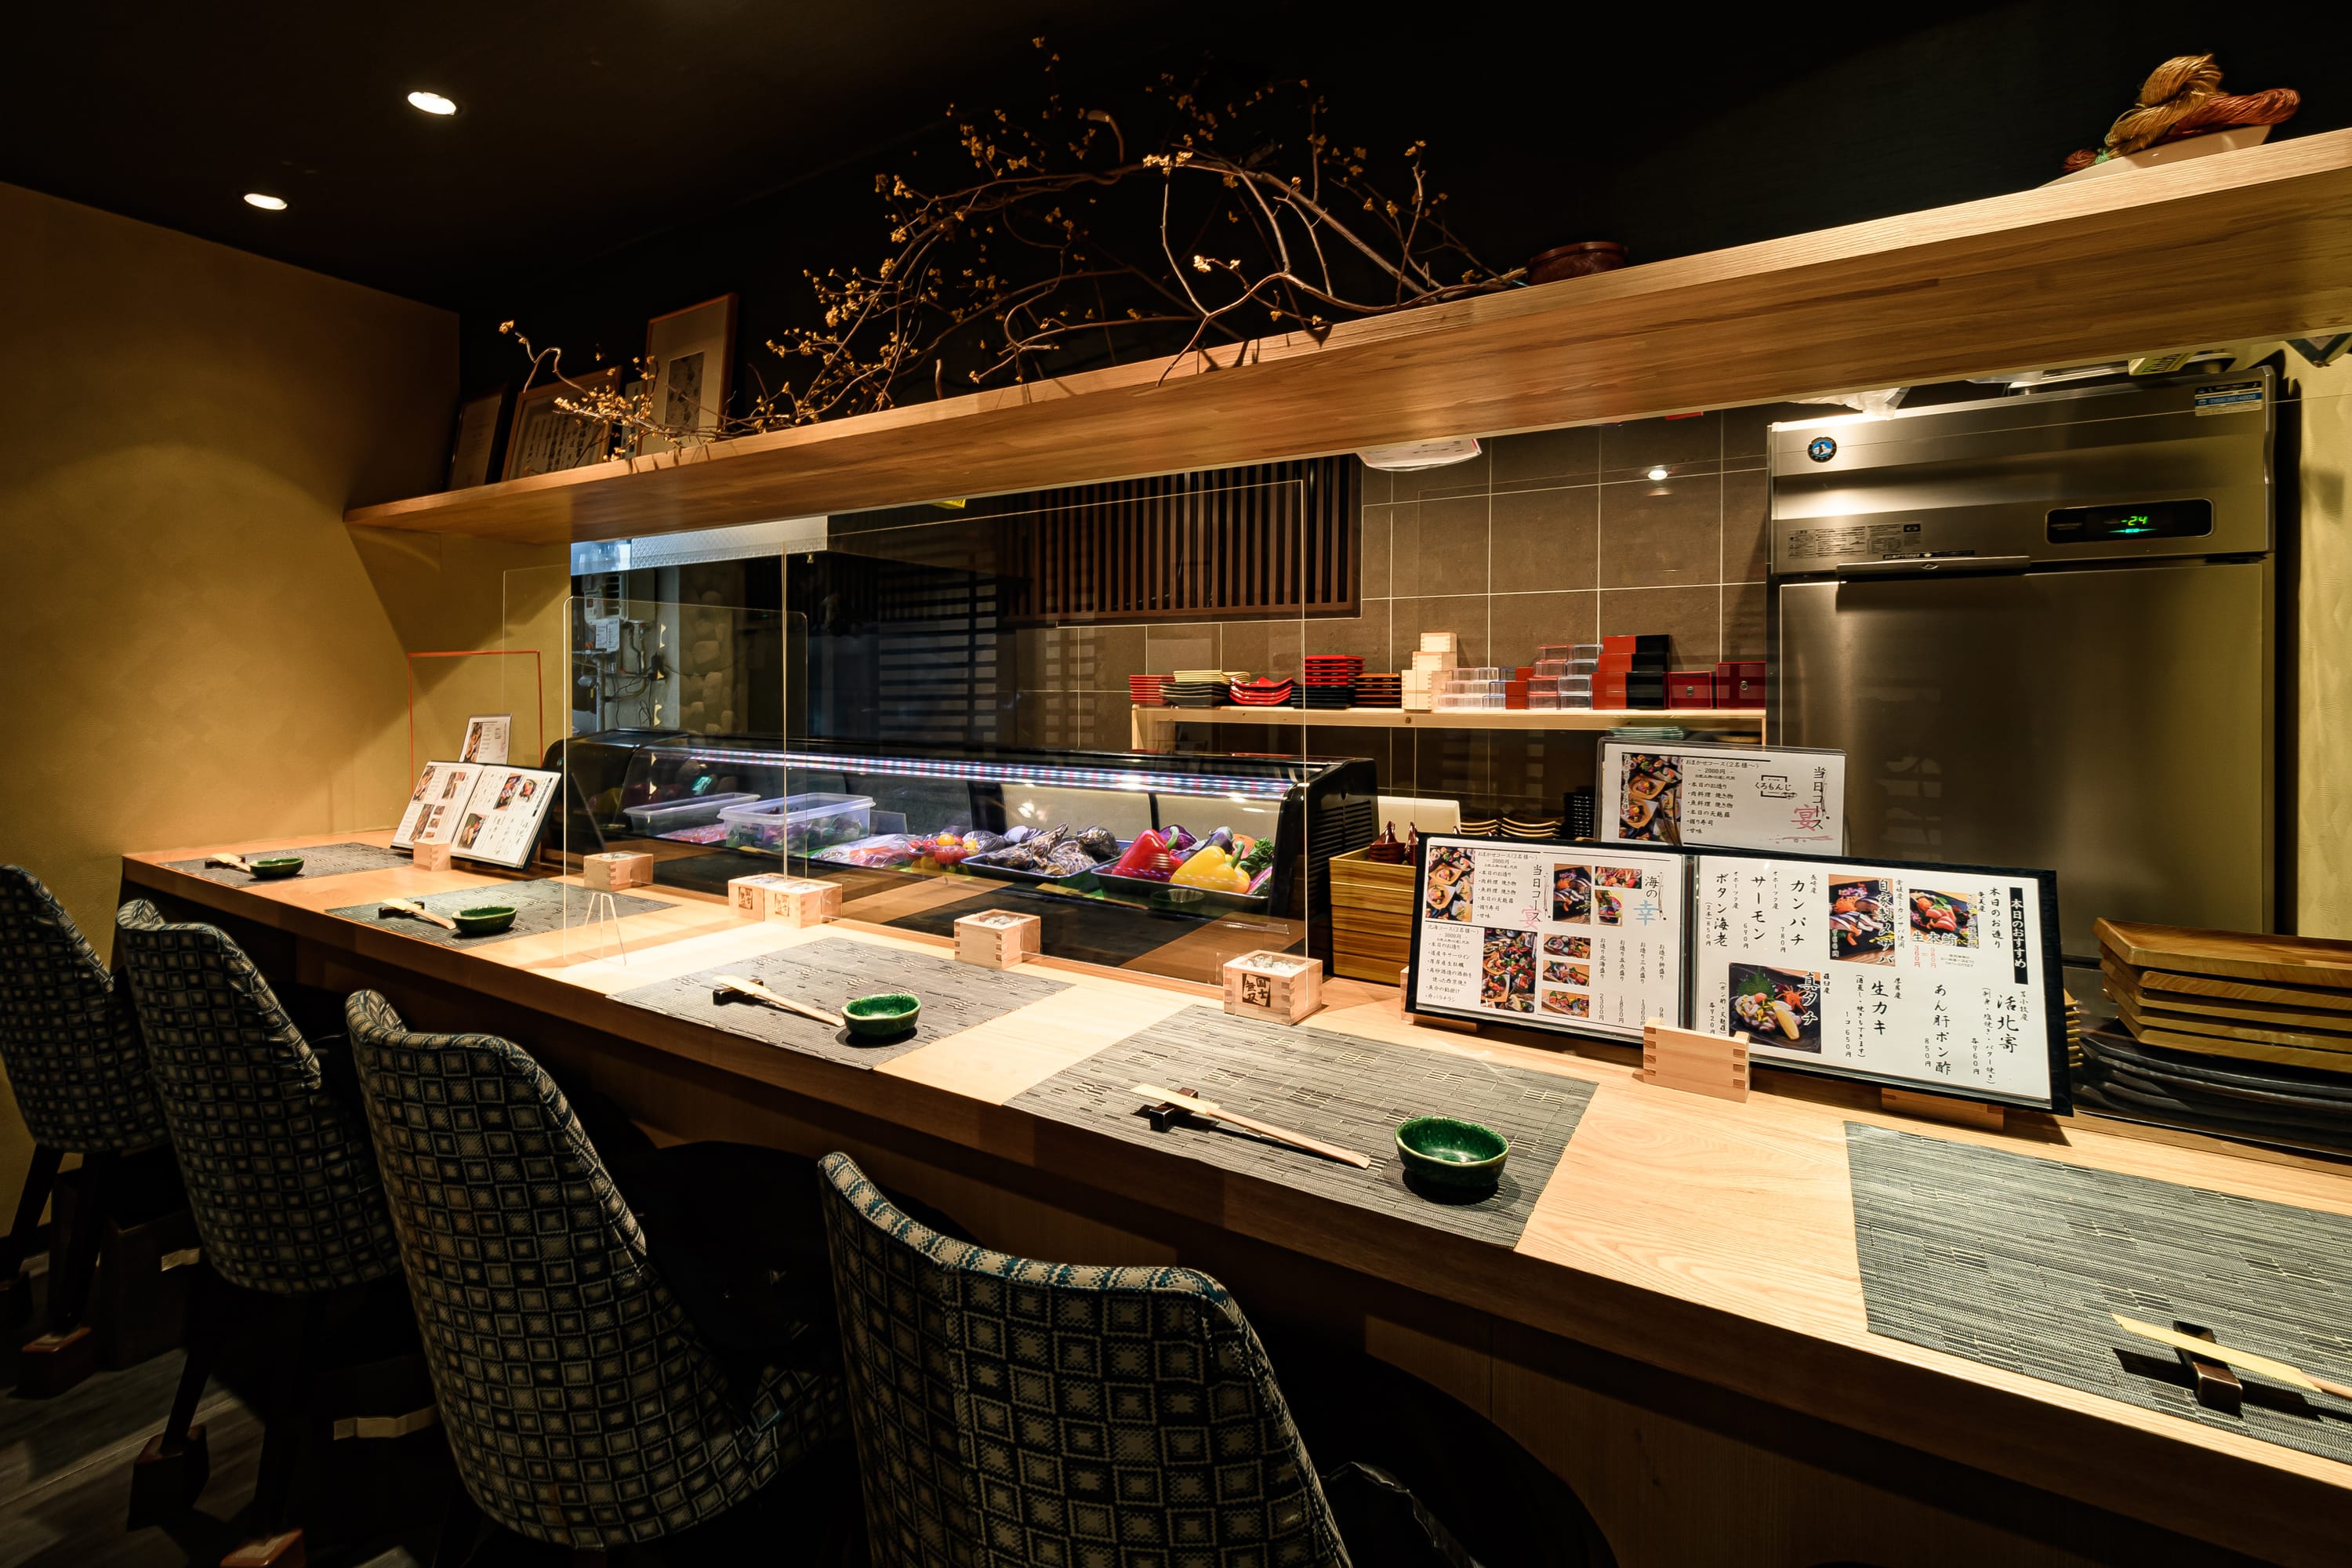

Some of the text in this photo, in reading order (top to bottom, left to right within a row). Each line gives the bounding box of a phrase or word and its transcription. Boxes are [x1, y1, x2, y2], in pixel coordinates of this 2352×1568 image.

[2121, 516, 2148, 526] -24
[1755, 782, 1791, 791] くろもんじ
[1791, 804, 1816, 832] 宴
[1633, 899, 1659, 927] 幸
[1646, 876, 1660, 898] 海の
[1713, 873, 1730, 947] ボタン海老
[1751, 877, 1766, 941] サーモン
[1789, 880, 1806, 946] カンパチ
[1989, 887, 2005, 949] 本日のお造り
[2010, 898, 2027, 969] 本日のおすすめ
[1871, 980, 1889, 1036] 生カキ
[1933, 984, 1951, 1076] あん肝ポン酢
[1997, 993, 2020, 1054] 活北寄
